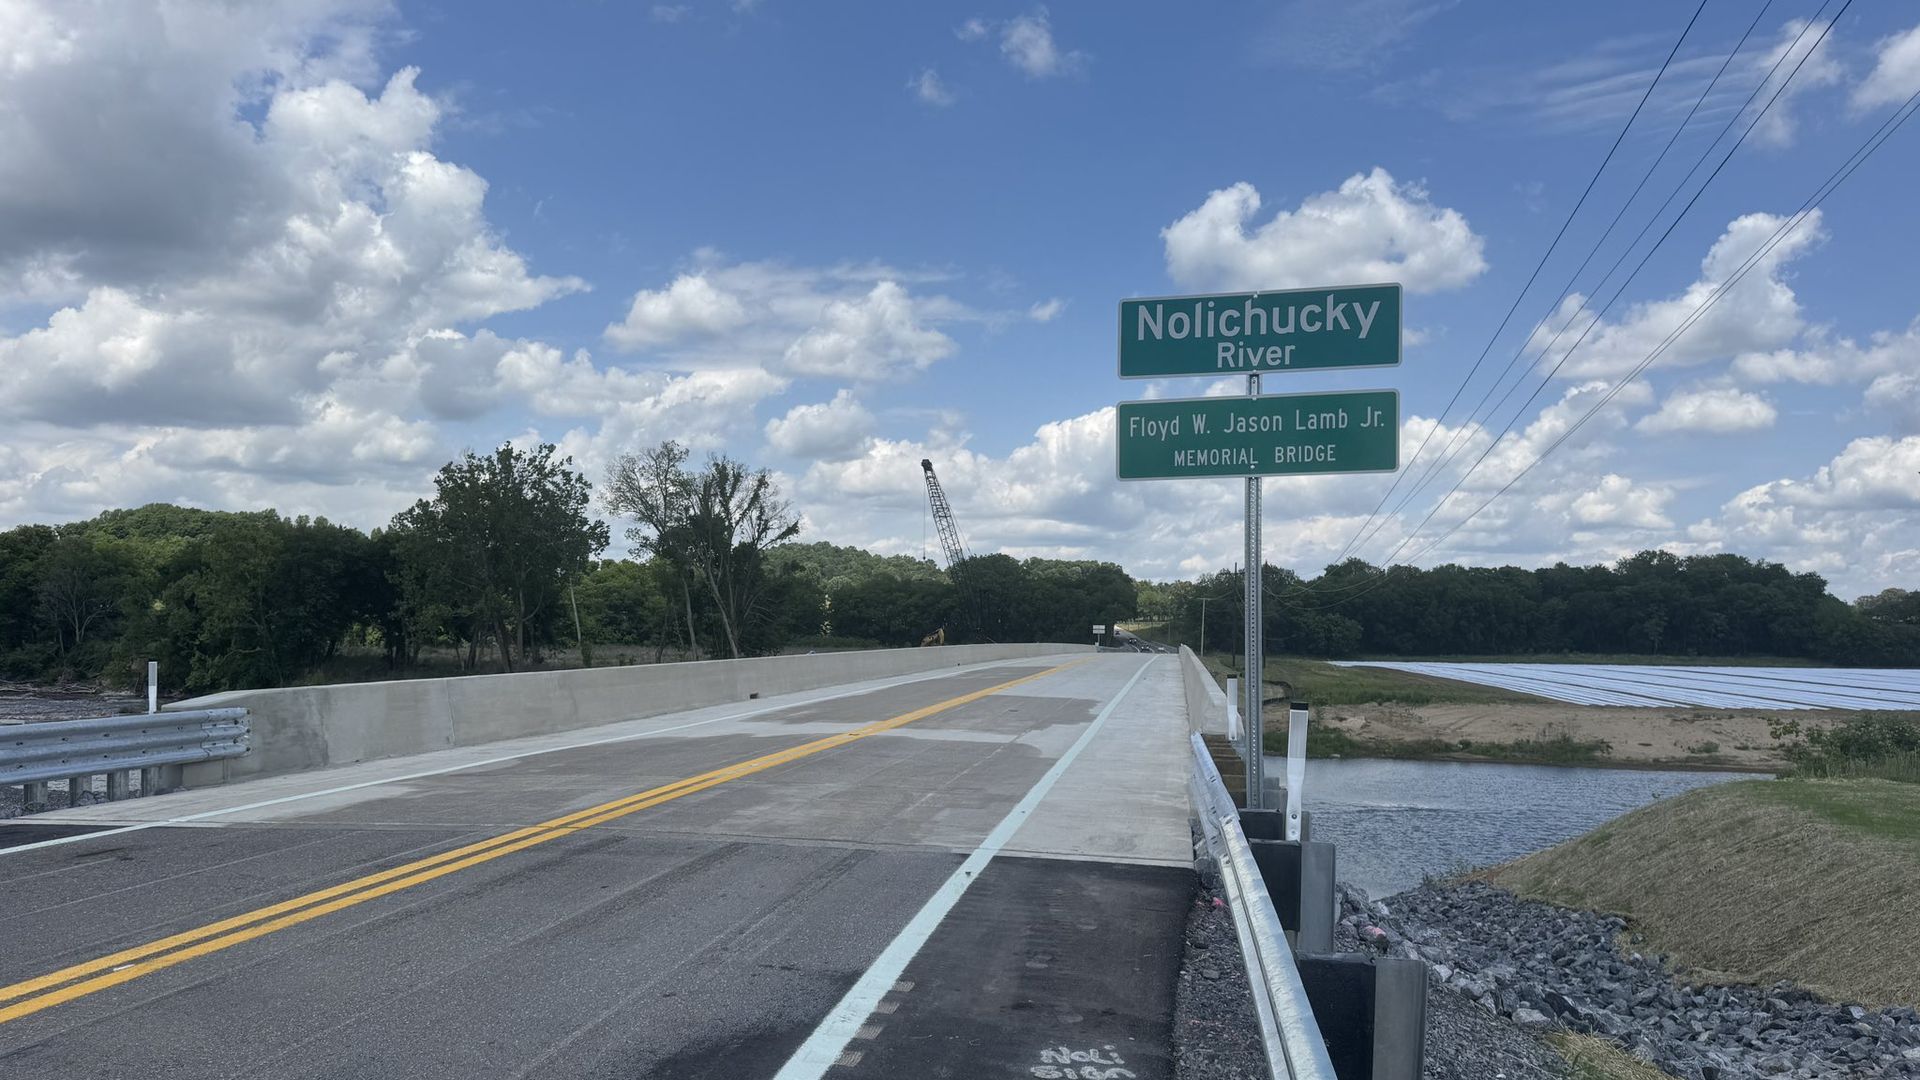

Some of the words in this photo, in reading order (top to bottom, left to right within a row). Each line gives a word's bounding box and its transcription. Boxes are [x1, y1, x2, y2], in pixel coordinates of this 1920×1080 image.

[1137, 294, 1380, 340] Nolichucky
[1217, 341, 1296, 368] River
[1130, 415, 1179, 441] Floyd
[1193, 414, 1211, 434] W.
[1224, 412, 1282, 433] Jason
[1296, 409, 1348, 430] Lamb
[1360, 406, 1385, 428] Jr.
[1174, 447, 1258, 467] MEMORIAL
[1275, 444, 1336, 463] BRIDGE
